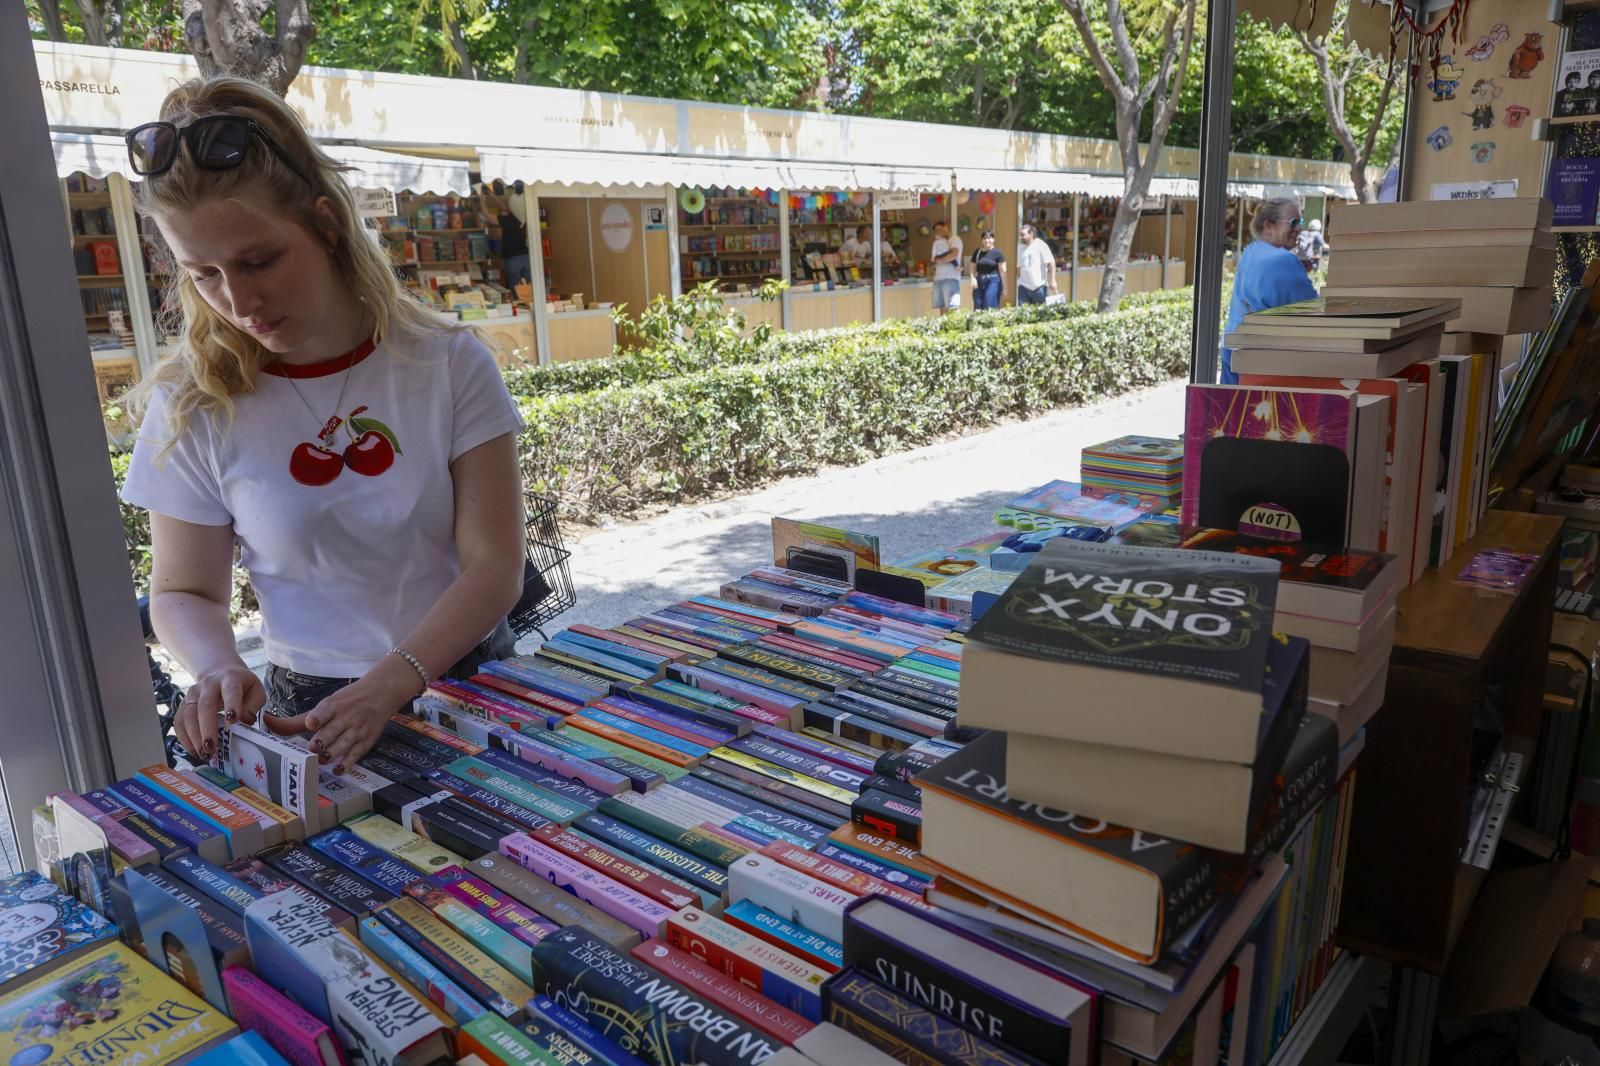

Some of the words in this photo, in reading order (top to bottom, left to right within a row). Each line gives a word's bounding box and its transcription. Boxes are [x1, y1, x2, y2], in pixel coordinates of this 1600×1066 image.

[39, 79, 121, 95] PASSARELLA
[1248, 508, 1293, 529] (NOT)
[1042, 566, 1246, 607] STORM
[1024, 592, 1232, 636] ONYX
[745, 652, 771, 662] IN
[767, 657, 843, 683] LOCKED
[707, 692, 739, 709] Place
[736, 702, 779, 722] Happy
[774, 749, 804, 763] CHLOE
[467, 788, 504, 807] Steel
[533, 796, 574, 819] EDWARD
[882, 798, 925, 816] ATTERSON
[943, 768, 1107, 834] CORT
[497, 801, 551, 829] Danielle
[745, 807, 783, 823] Card
[341, 838, 368, 855] POINT
[855, 831, 884, 846] END
[287, 846, 325, 870] DEMONS
[583, 847, 615, 865] LYING
[645, 842, 706, 874] ILLUSIONS
[780, 847, 820, 868] HENRY
[372, 868, 399, 885] DAN
[375, 856, 419, 884] BROWN
[700, 868, 728, 885] THE
[816, 862, 854, 881] EMILY
[325, 882, 351, 899] DAN
[328, 869, 373, 898] BROWN
[861, 880, 889, 895] LIFE
[477, 892, 501, 908] CHRIS
[807, 884, 846, 906] LIARS
[266, 907, 316, 948] NEVER
[287, 900, 339, 939] FLINCH
[754, 911, 780, 927] END
[775, 922, 795, 935] THE
[802, 934, 825, 949] DIE
[567, 944, 618, 977] SECRET
[581, 939, 639, 975] SECRETS
[744, 942, 809, 977] CHEMISTRY
[611, 969, 636, 986] THE
[666, 955, 716, 985] THREADS
[361, 977, 427, 1026] KING
[713, 980, 770, 1014] INFINITE
[875, 957, 1003, 1038] SUNRISE
[344, 988, 401, 1039] STEPHEN
[633, 976, 740, 1044] BROWN
[488, 1030, 532, 1061] HENRY
[543, 1031, 592, 1065] RIORDAN
[547, 1044, 571, 1065] RICK
[725, 1033, 778, 1066] AN
